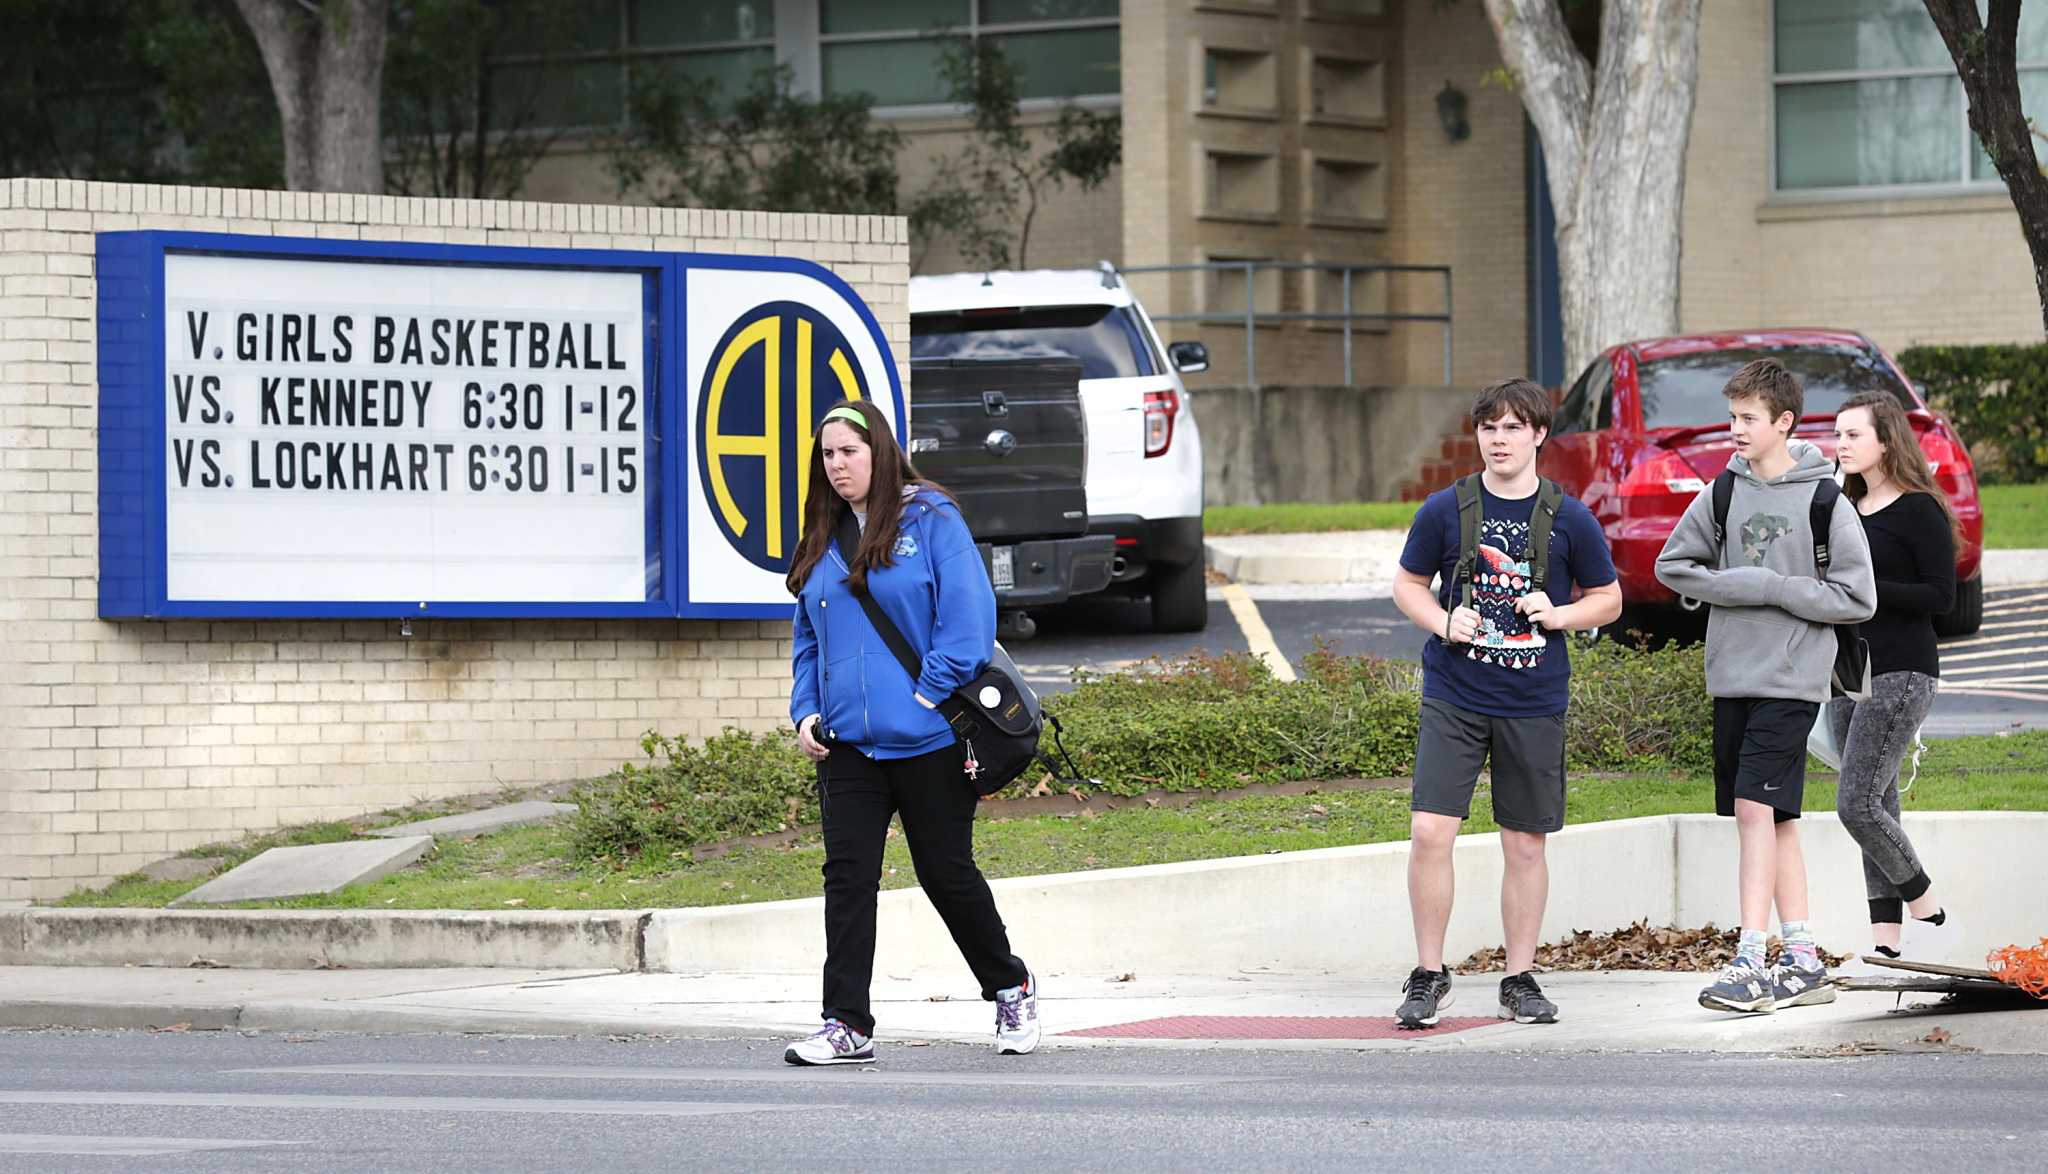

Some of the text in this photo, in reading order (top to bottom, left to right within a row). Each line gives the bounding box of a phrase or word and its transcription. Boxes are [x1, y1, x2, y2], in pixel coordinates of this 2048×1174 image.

[186, 310, 627, 371] V. GIRLS BASKETBALL
[172, 374, 637, 432] VS. KENNEDY 6:30 1-12
[172, 438, 637, 494] VS. LOCKHART 6:30 1-15
[1747, 980, 1762, 999] N
[1783, 975, 1806, 994] N
